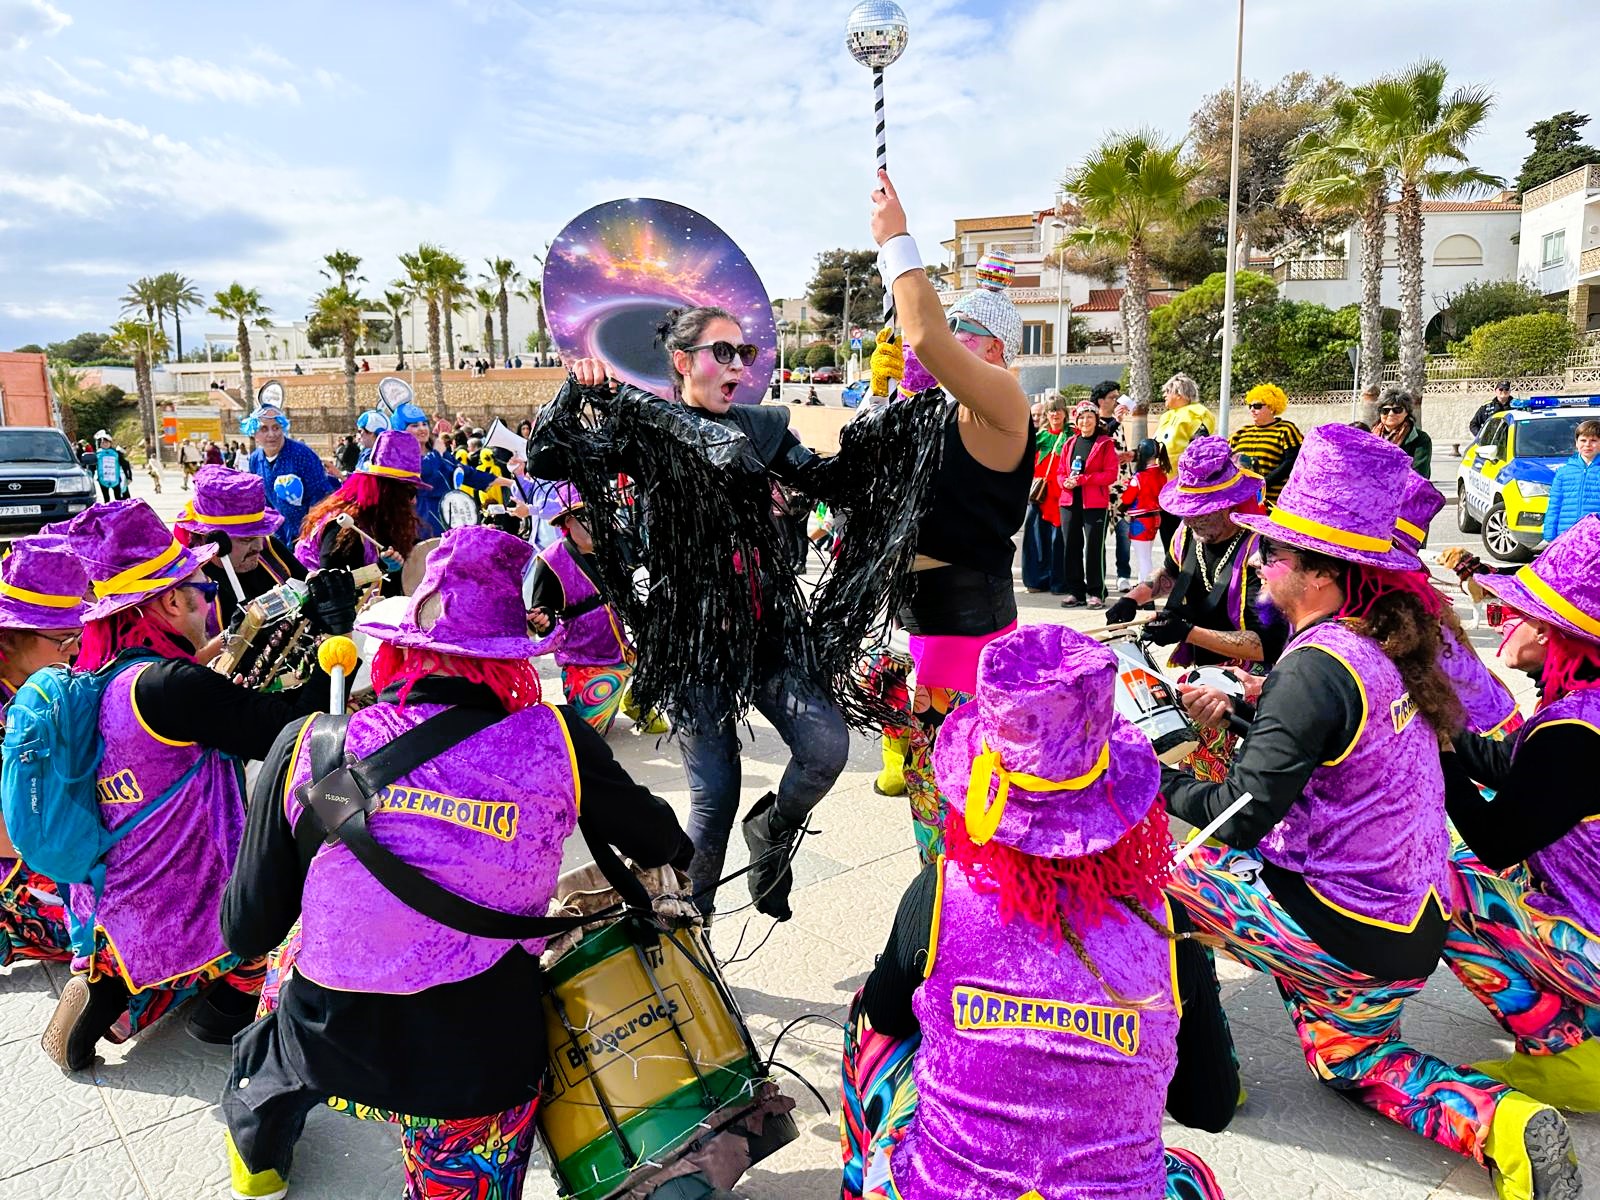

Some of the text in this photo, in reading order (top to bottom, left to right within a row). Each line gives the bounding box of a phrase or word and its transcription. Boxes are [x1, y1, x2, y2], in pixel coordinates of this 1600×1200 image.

[97, 772, 140, 801] LICS
[379, 786, 516, 838] RREMBOLICS
[956, 992, 1136, 1052] TORREMBOLICS
